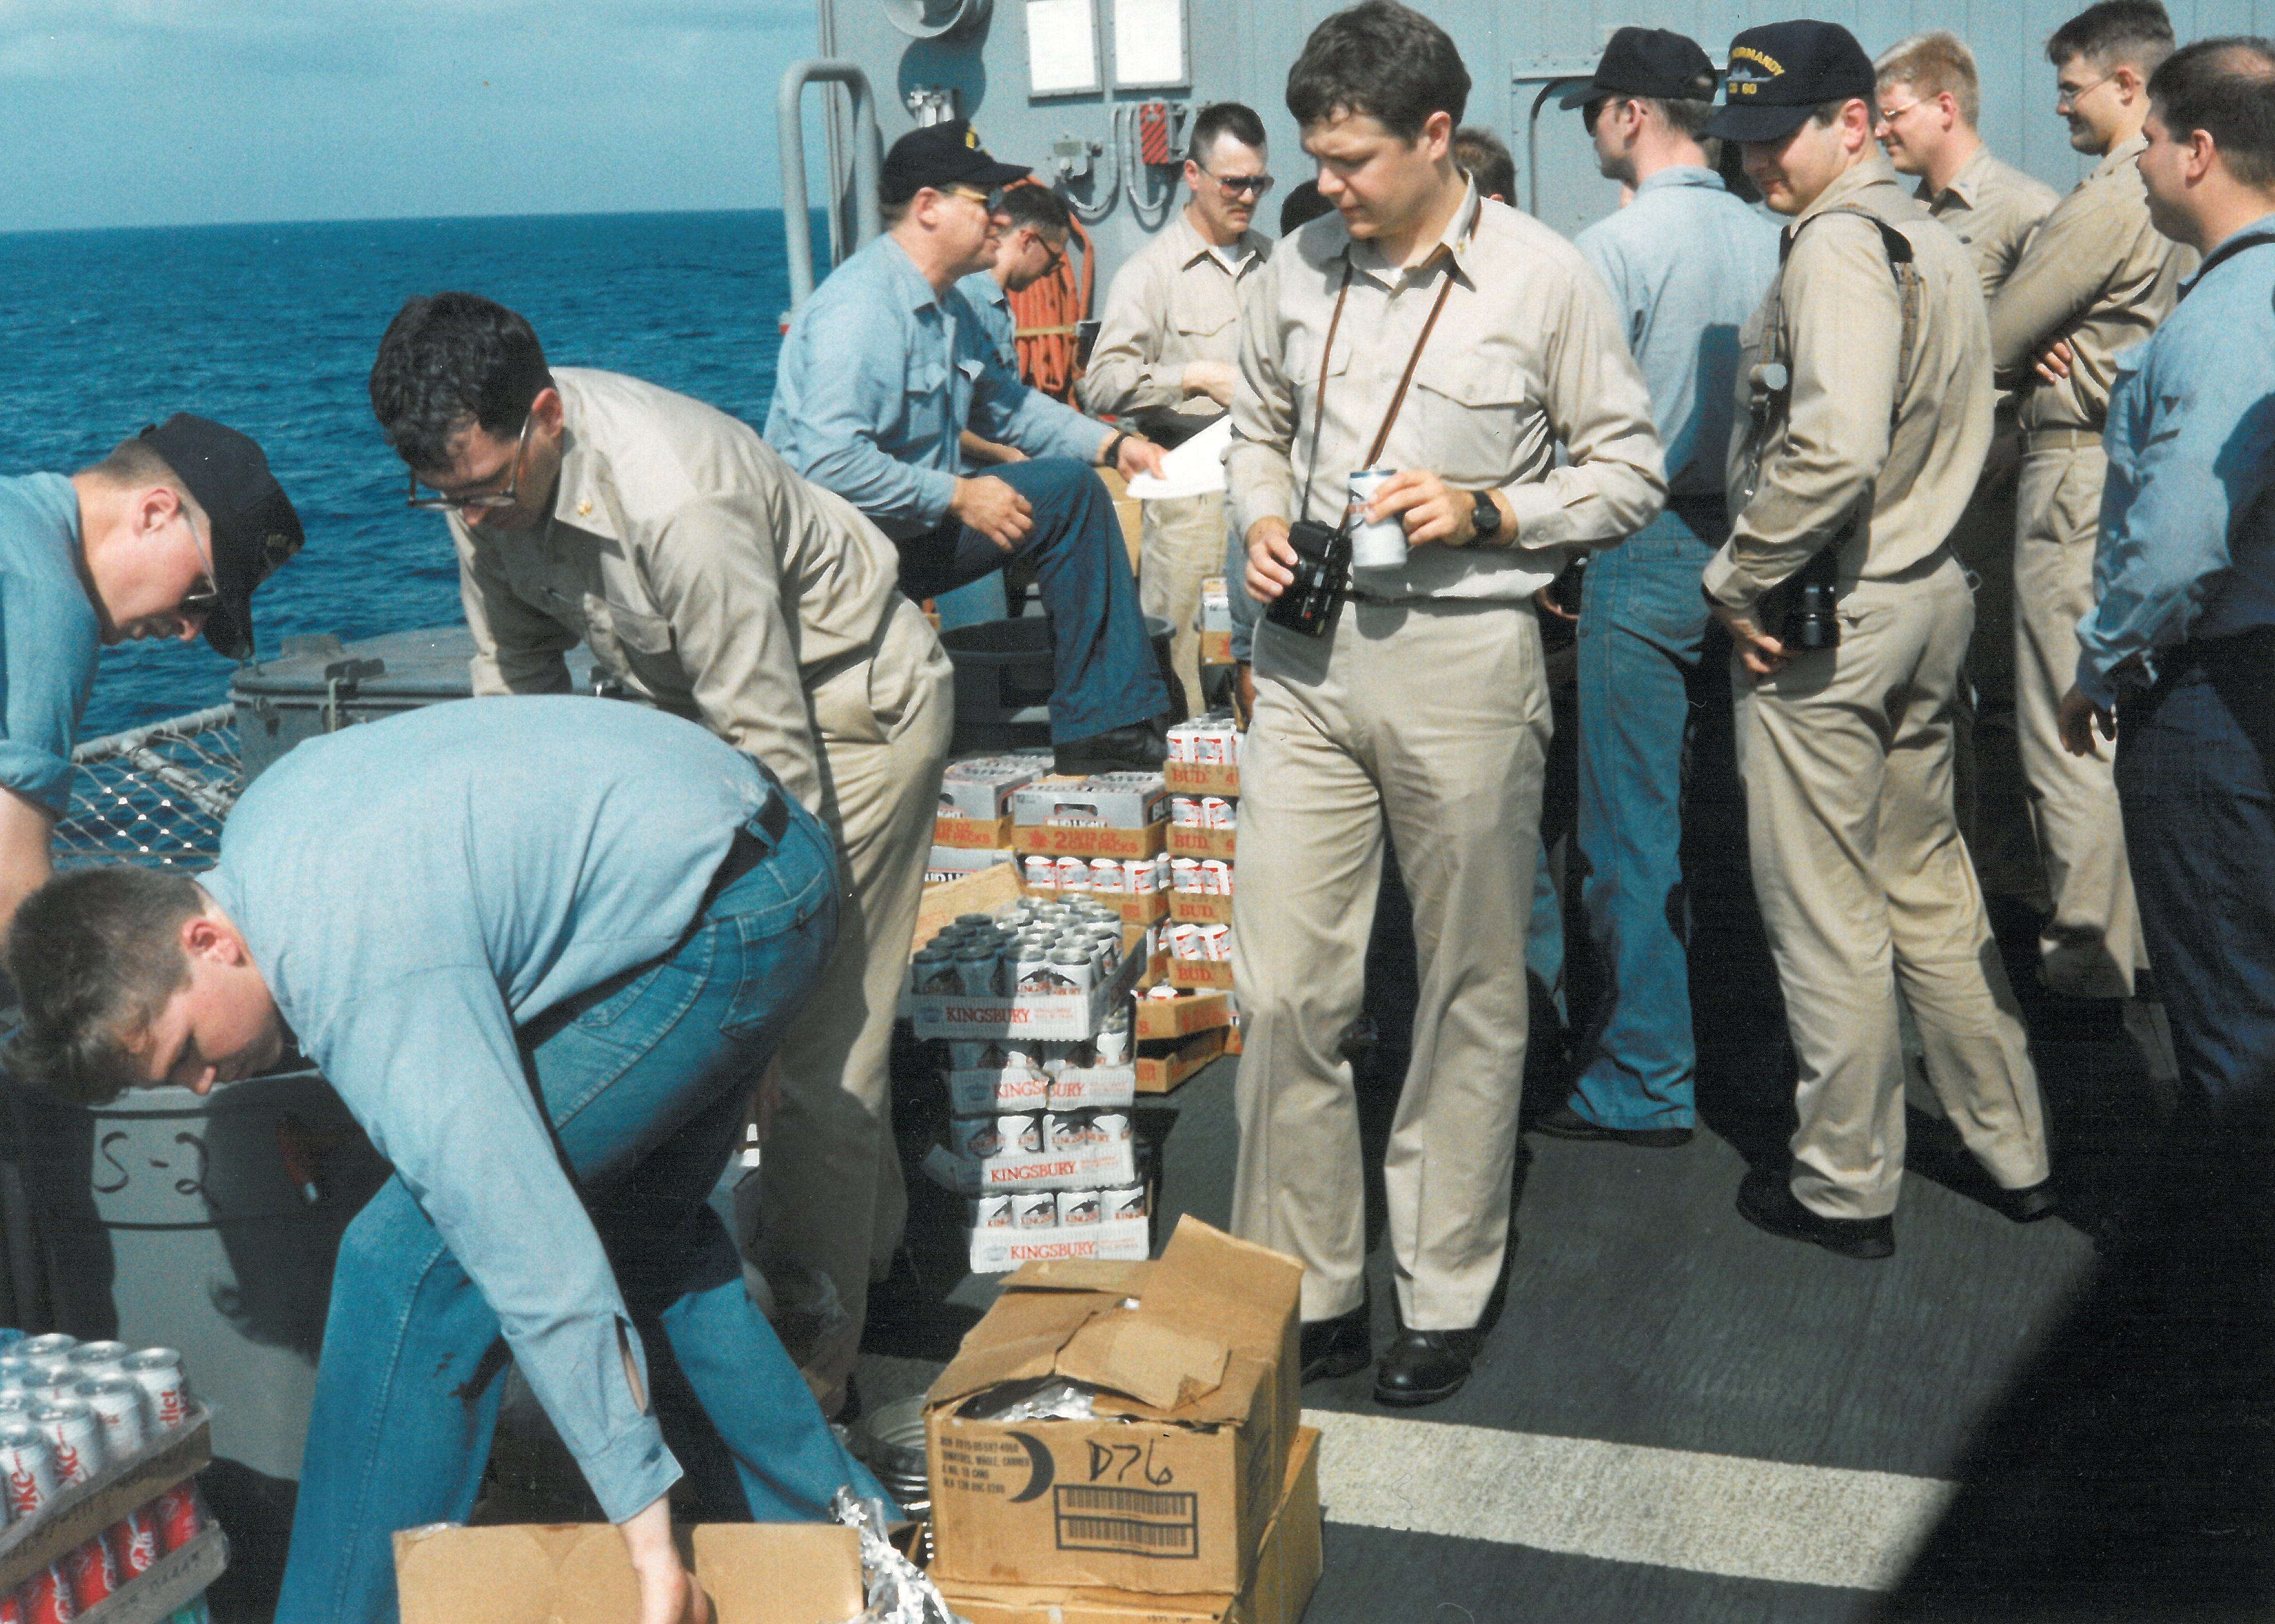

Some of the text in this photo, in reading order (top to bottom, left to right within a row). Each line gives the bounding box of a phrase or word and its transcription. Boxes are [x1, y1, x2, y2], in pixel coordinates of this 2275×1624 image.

[946, 1005, 1031, 1024] KINGSBURY
[993, 1078, 1084, 1099] KINGSBURY
[991, 1161, 1076, 1184] KINGSBURY
[1010, 1241, 1096, 1261] KINGSBURY
[1085, 1438, 1174, 1488] D76
